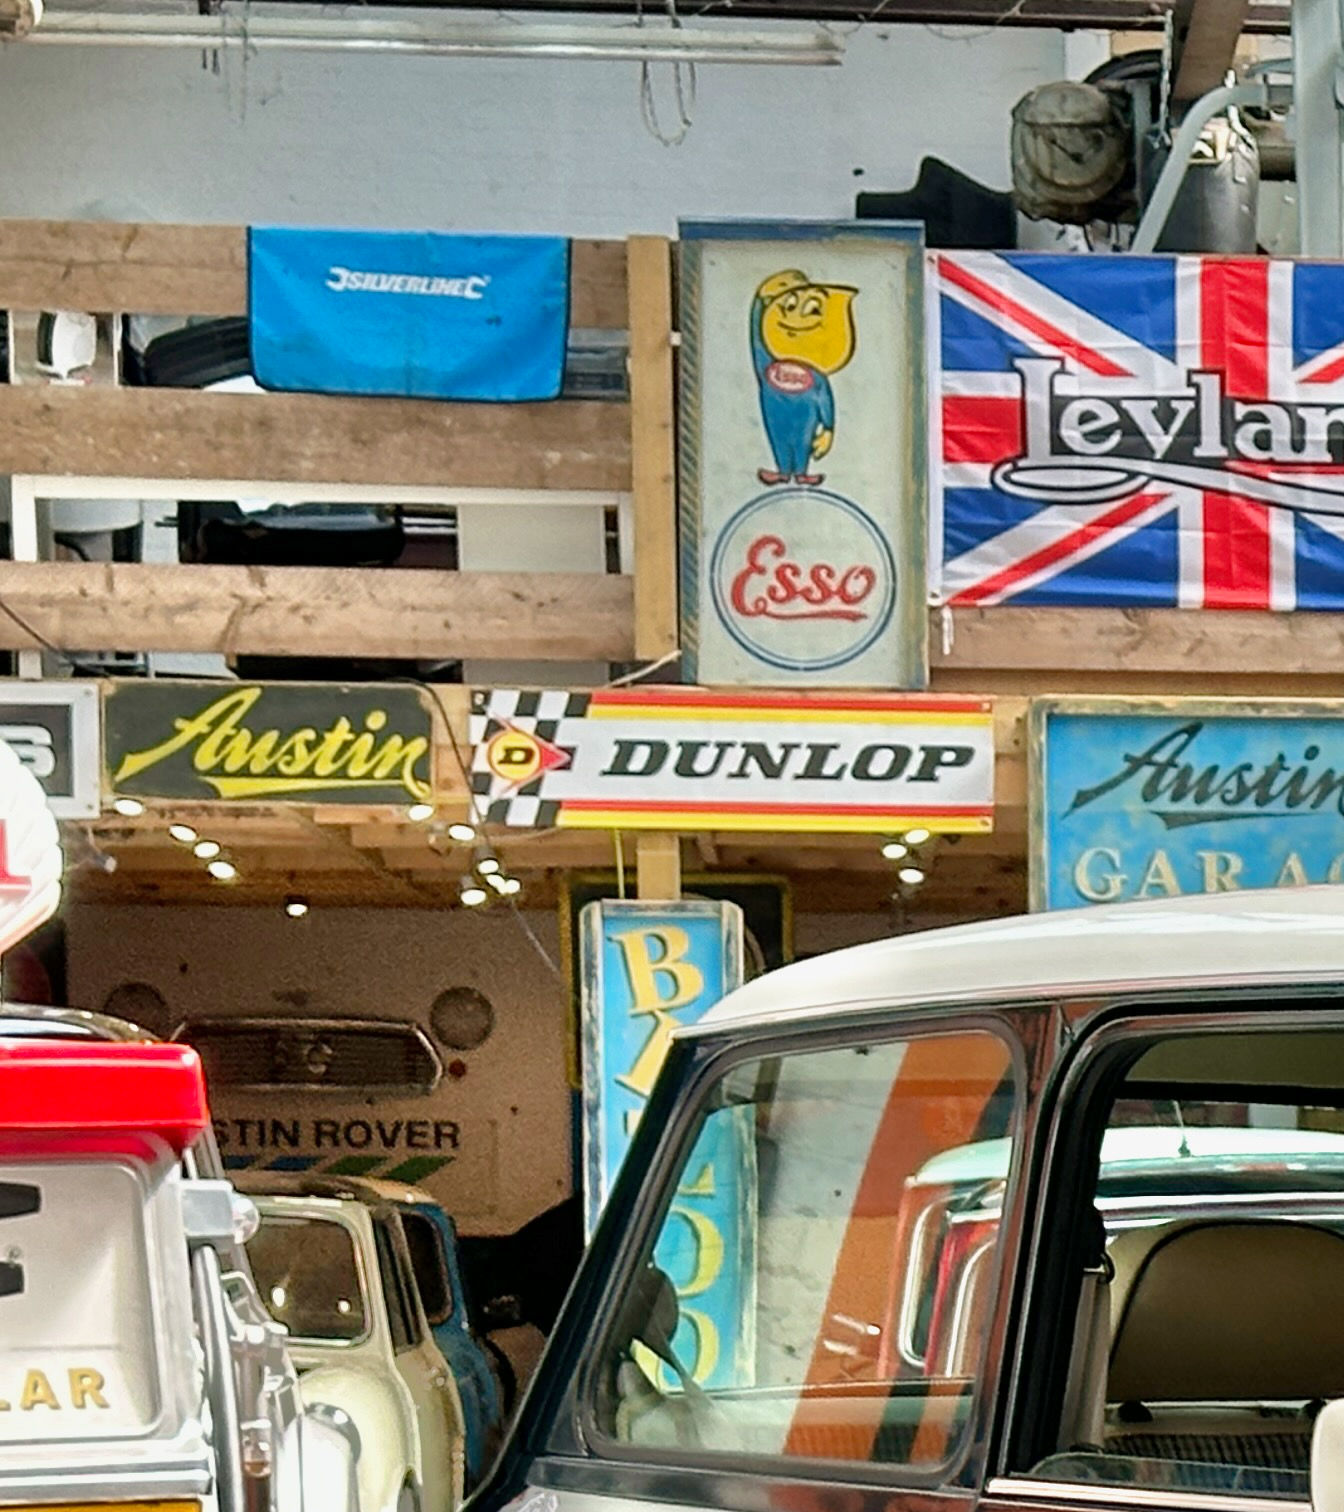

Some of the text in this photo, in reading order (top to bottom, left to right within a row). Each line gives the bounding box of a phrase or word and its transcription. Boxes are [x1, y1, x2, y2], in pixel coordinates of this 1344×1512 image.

[344, 270, 468, 299] SILVERLINE
[730, 534, 878, 622] Esso
[114, 685, 433, 800] Austin
[600, 738, 975, 784] DUNLOP
[313, 1118, 463, 1151] ROVER
